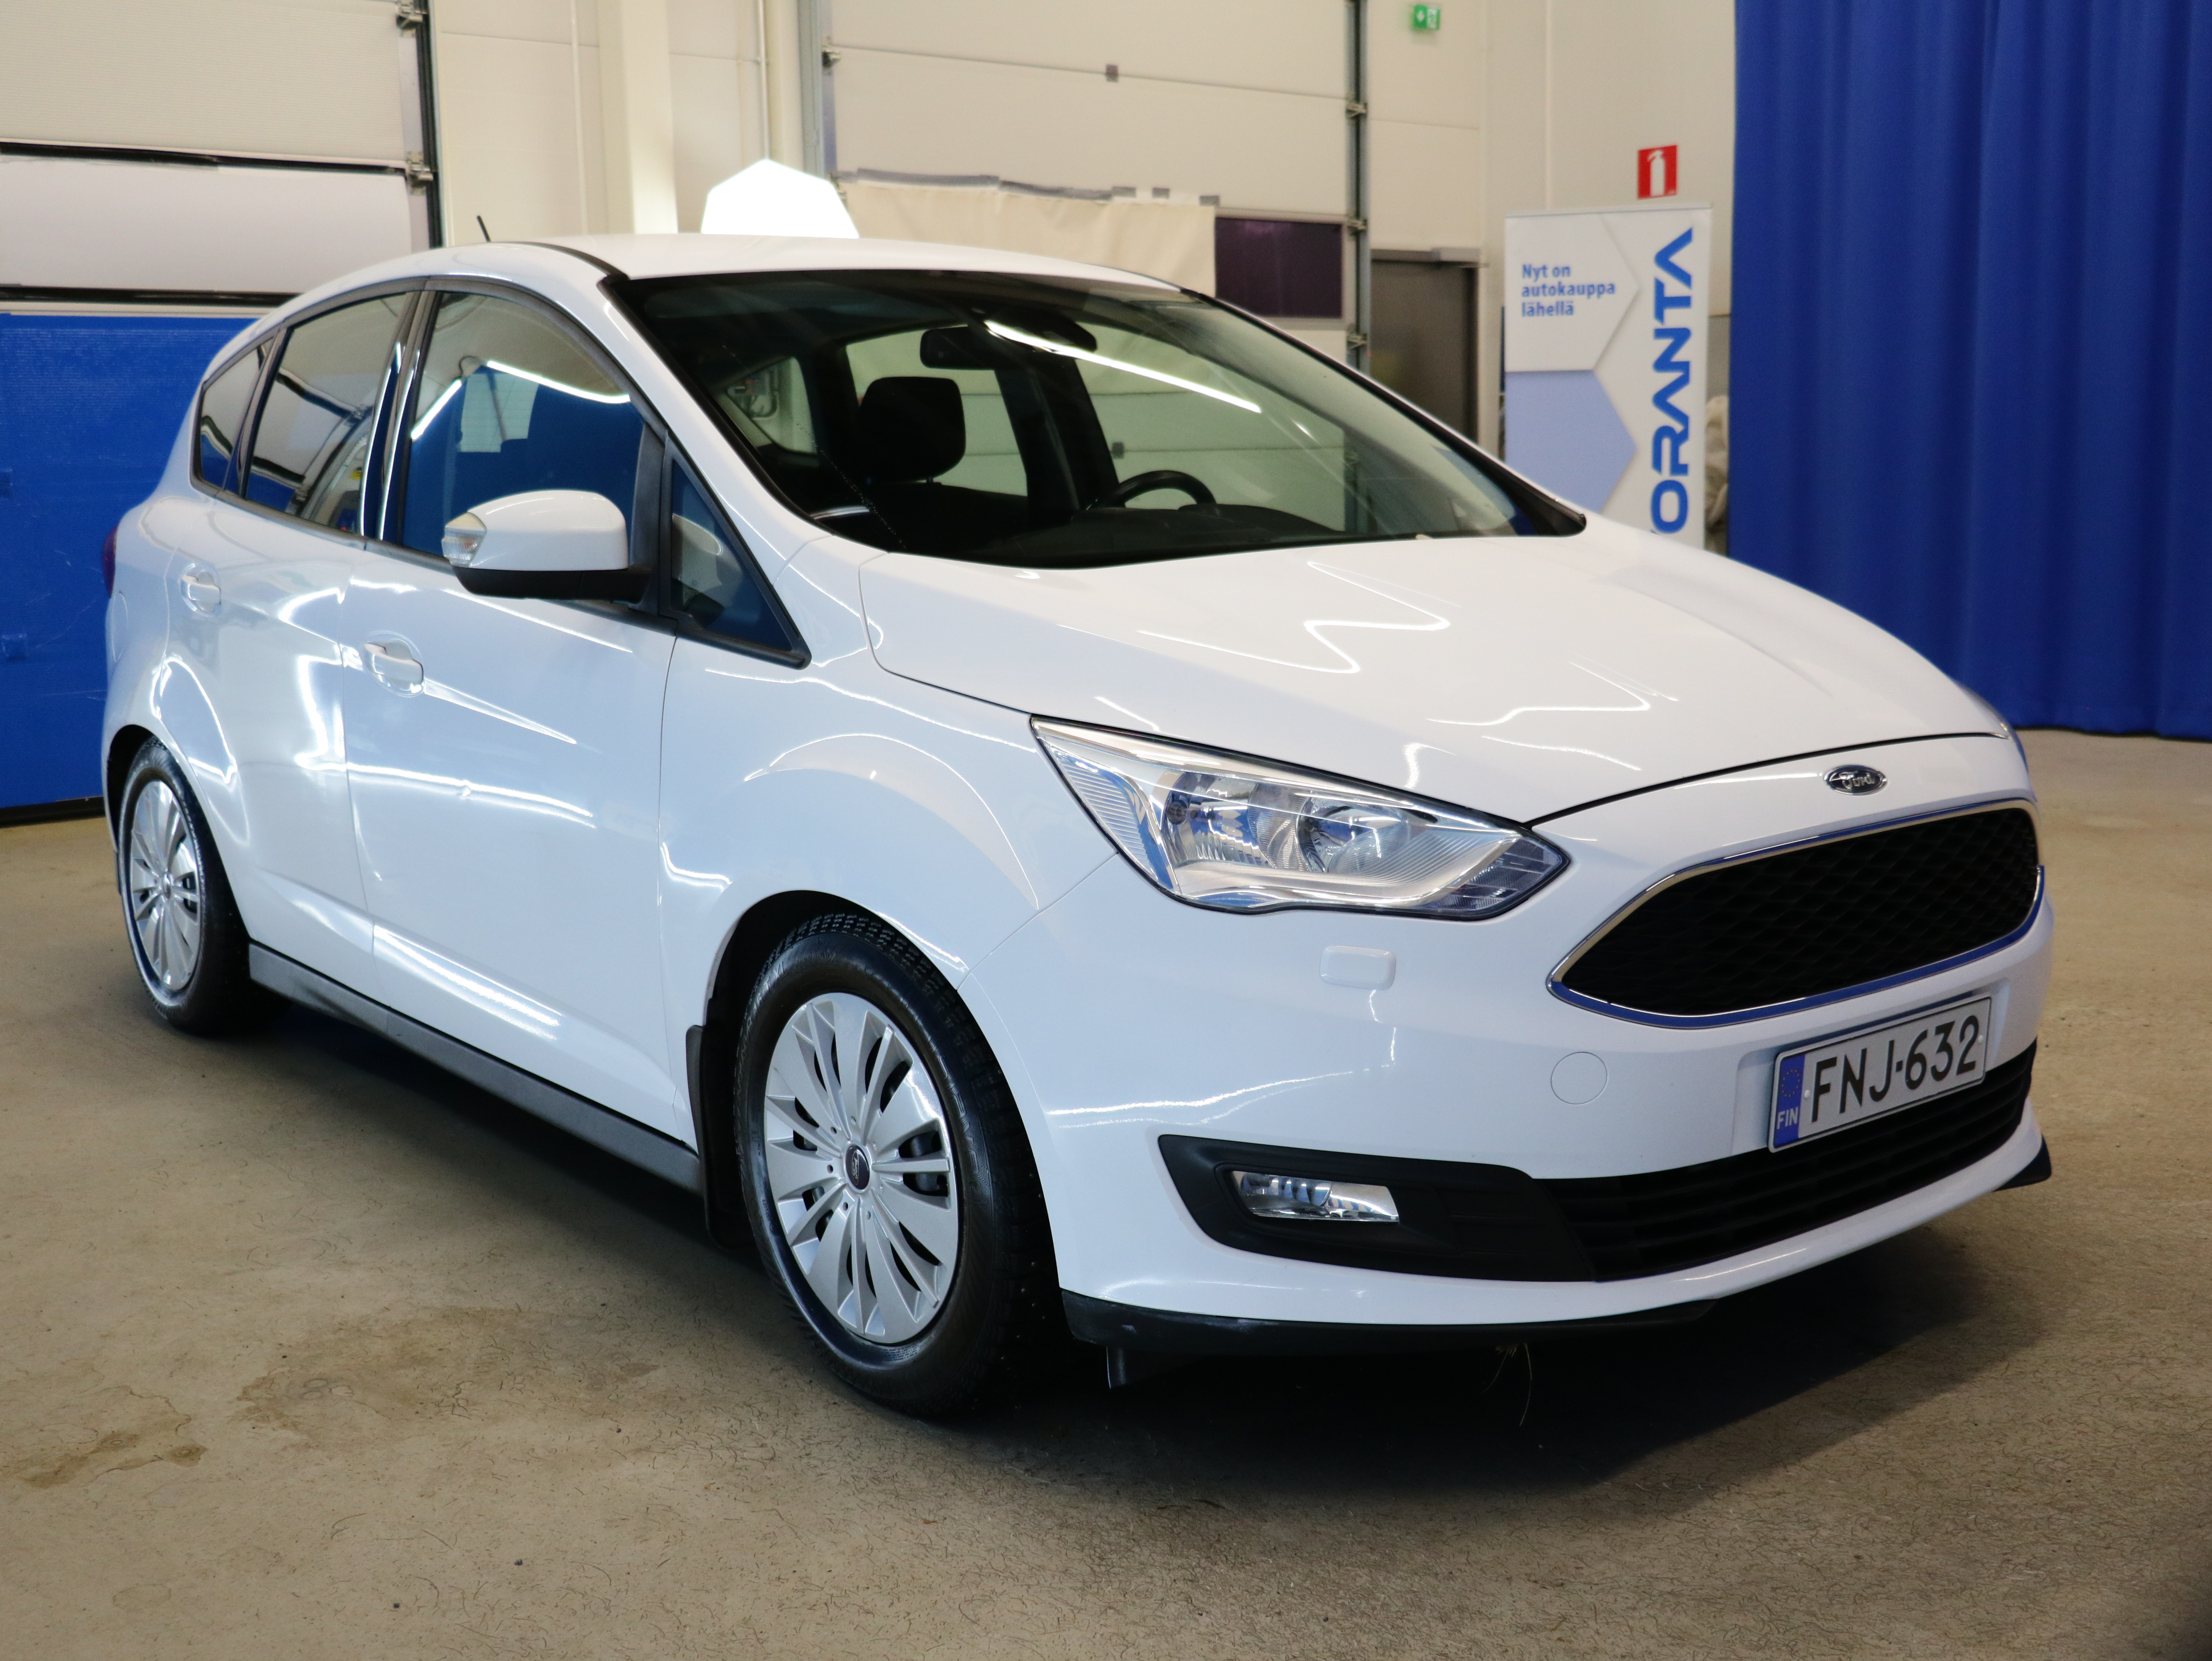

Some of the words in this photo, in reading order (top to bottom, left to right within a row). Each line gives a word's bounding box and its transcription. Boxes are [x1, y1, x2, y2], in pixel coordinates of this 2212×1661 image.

[1522, 265, 1548, 282] Nyt
[1552, 267, 1571, 277] on
[1522, 282, 1615, 299] autokauppa
[1522, 301, 1574, 317] lähellä
[1650, 227, 1693, 534] ORANTA
[1838, 770, 1875, 789] Ford
[1811, 1016, 1979, 1123] FNJ-632
[1776, 1106, 1799, 1130] FIN
